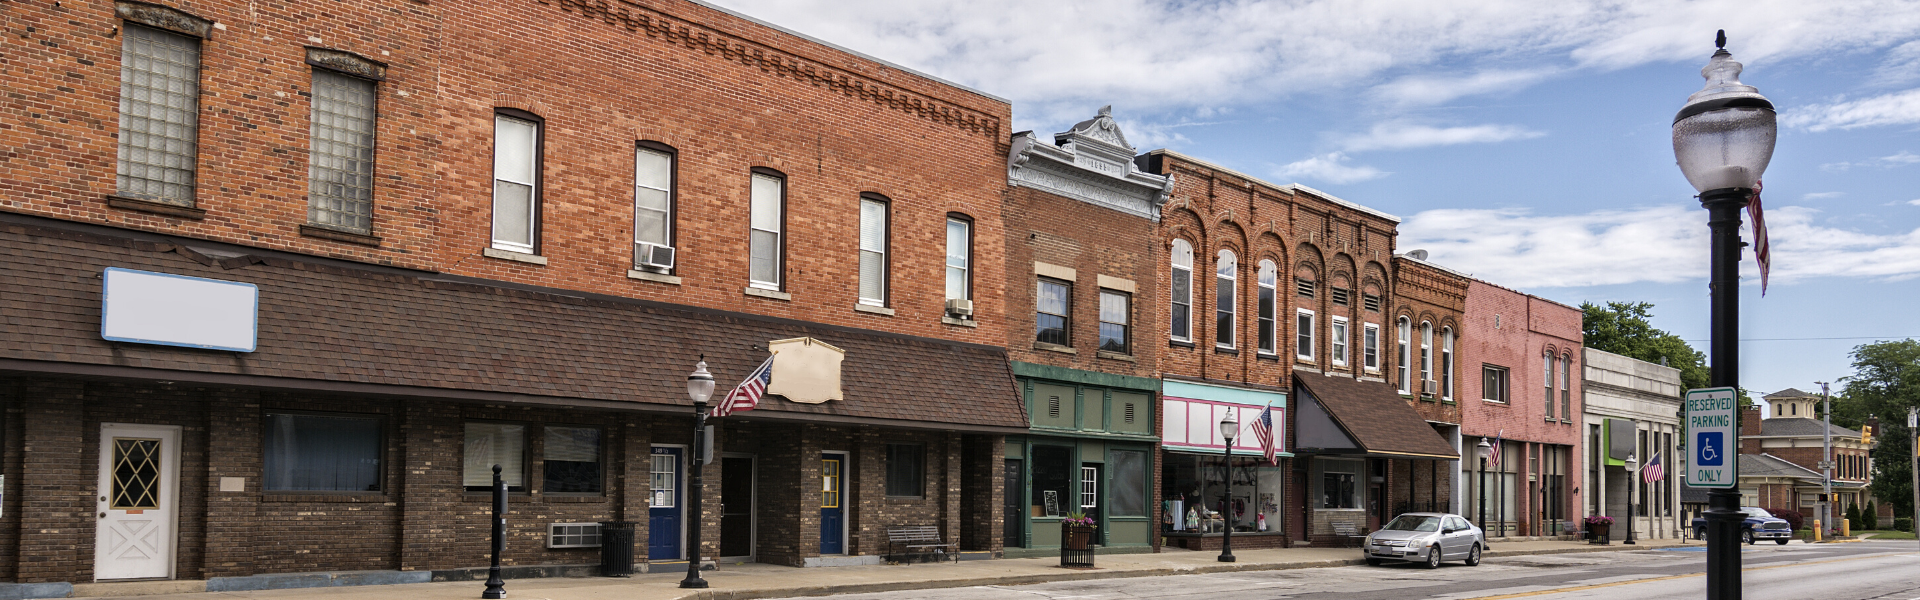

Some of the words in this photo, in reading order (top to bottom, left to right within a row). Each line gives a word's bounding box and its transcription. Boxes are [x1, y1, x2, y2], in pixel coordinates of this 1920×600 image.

[1689, 398, 1732, 411] RESERVED
[1692, 415, 1729, 427] PARKING
[1698, 470, 1722, 481] ONLY
